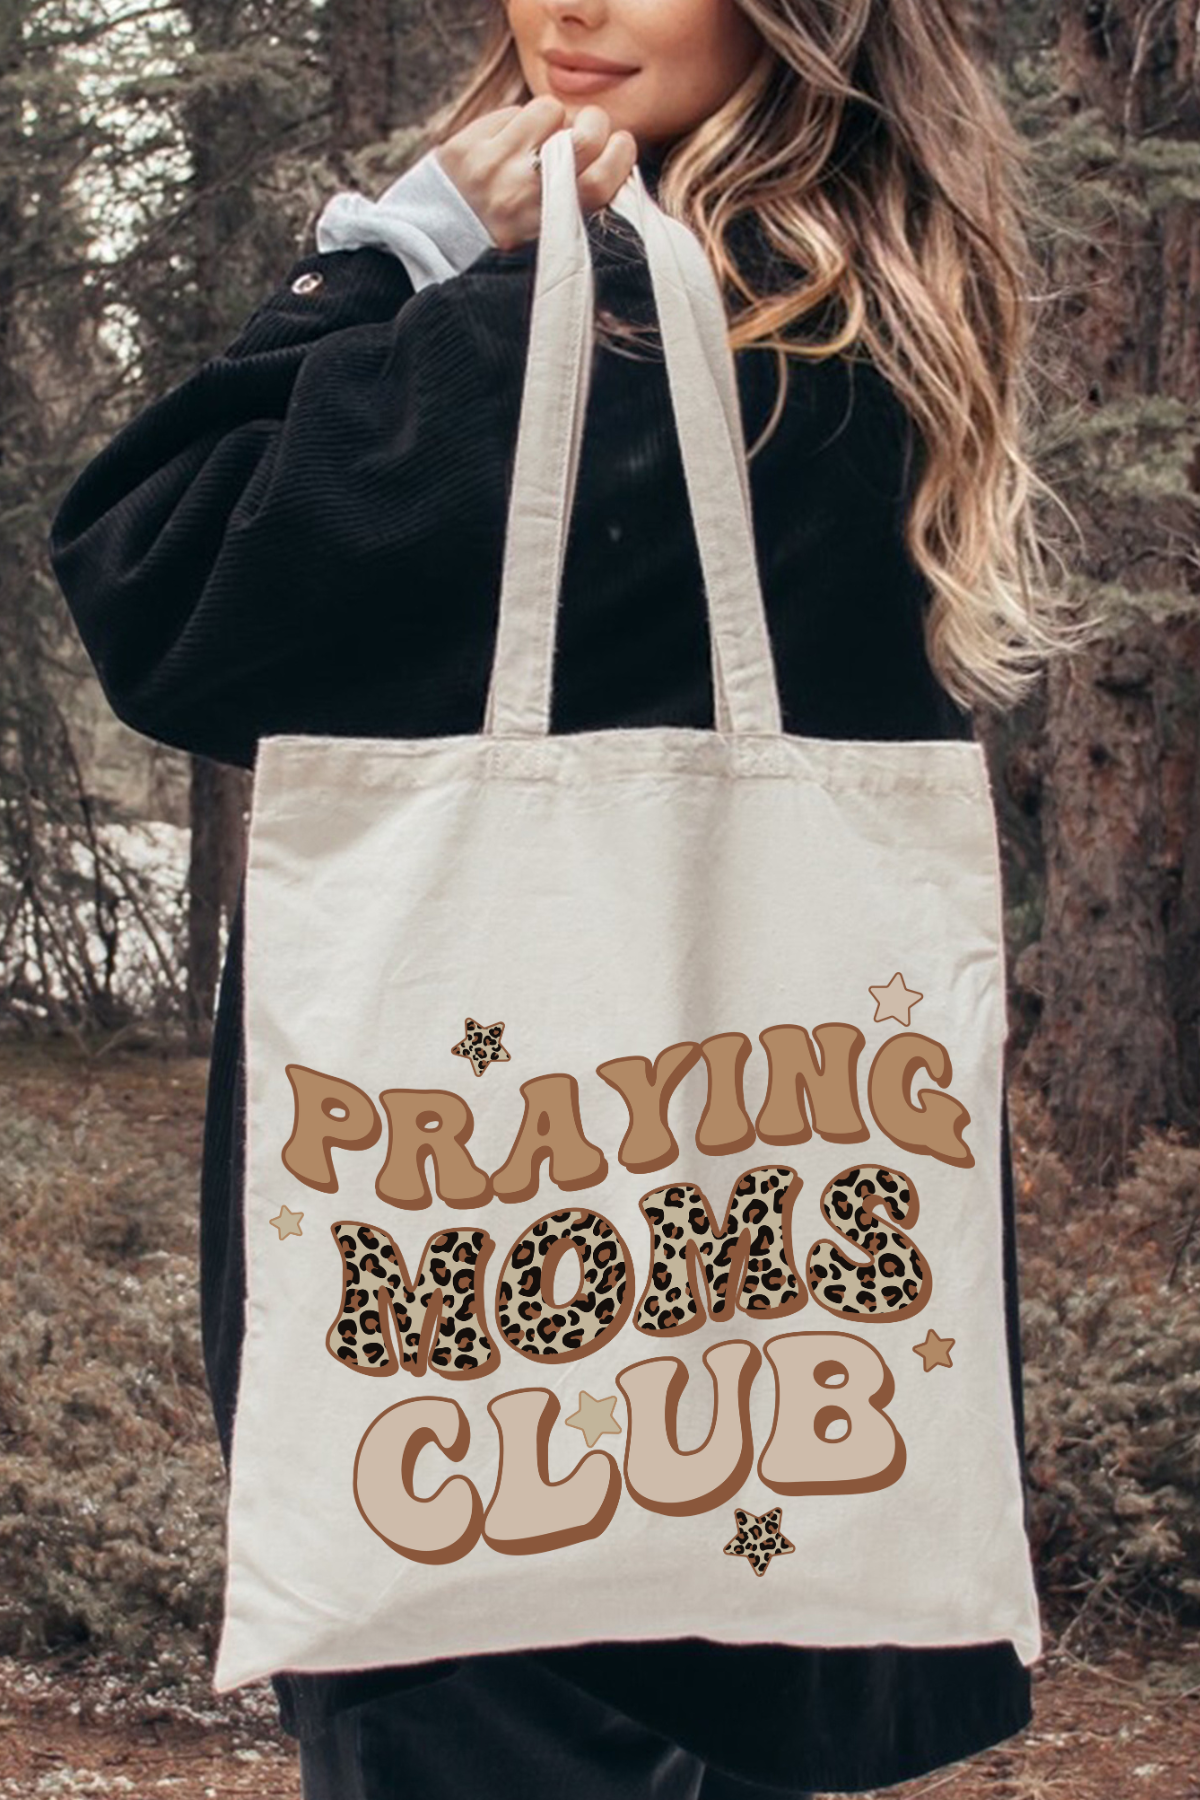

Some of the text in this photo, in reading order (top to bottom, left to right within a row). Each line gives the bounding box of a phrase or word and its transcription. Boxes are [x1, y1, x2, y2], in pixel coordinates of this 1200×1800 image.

[281, 1022, 975, 1210] PRAYING
[325, 1164, 933, 1381] MOMS
[353, 1330, 907, 1565] CLUB
